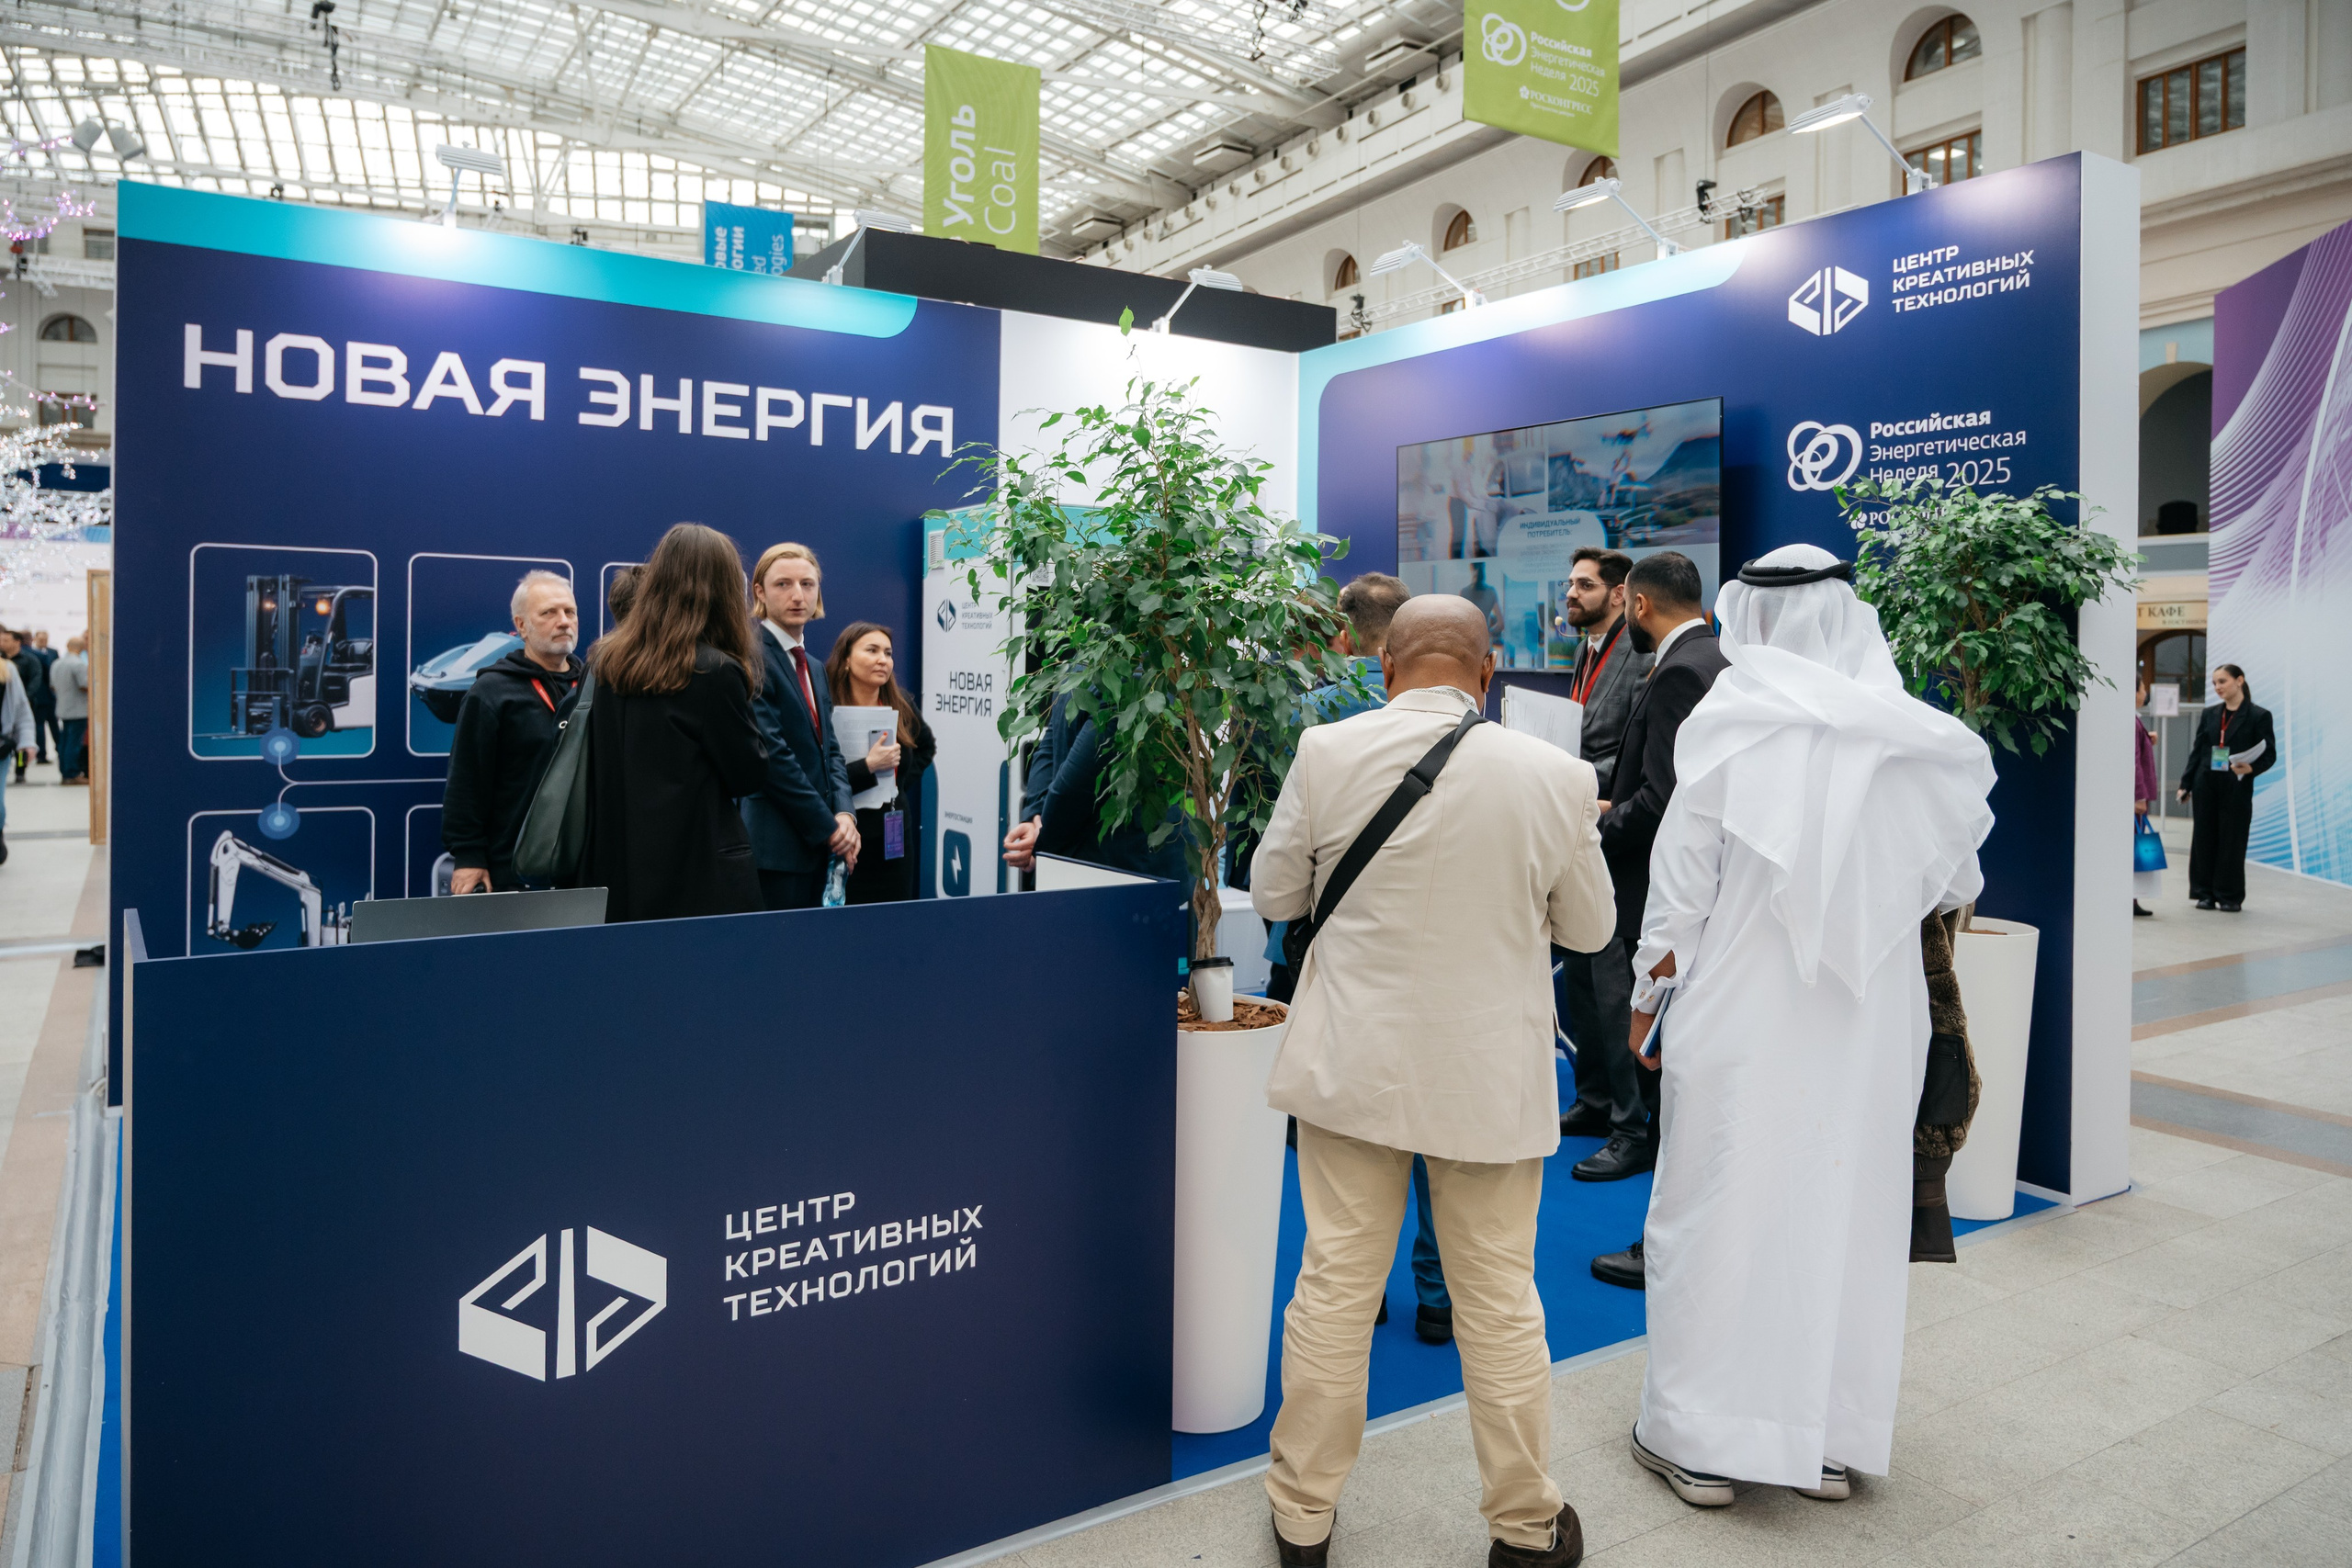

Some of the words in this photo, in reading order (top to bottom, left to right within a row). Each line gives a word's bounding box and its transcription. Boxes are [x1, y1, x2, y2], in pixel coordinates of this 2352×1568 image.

[1531, 31, 1592, 58] Российская
[1531, 47, 1605, 77] Энергетическая
[1531, 62, 1566, 81] Неделя
[1569, 73, 1600, 97] 2025
[1530, 89, 1593, 115] РОСКОНГРЕСС
[944, 104, 976, 228] Уголь
[984, 146, 1016, 235] Coal
[1892, 244, 1960, 274] ЦЕНТР
[1892, 249, 2034, 293] КРЕАТИВНЫХ
[1892, 268, 2030, 313] ТЕХНОЛОГИЙ
[184, 322, 545, 421] НОВАЯ
[578, 367, 954, 458] ЭНЕРГИЯ
[1870, 410, 1992, 439] Российская
[1870, 430, 2027, 463] Энергетическая
[1944, 457, 2011, 489] 2025
[1520, 517, 1580, 530] ИНДИВИДУАЛЬНЫЙ
[961, 620, 992, 629] ТЕХНОЛОГИЙ
[2148, 606, 2185, 617] КАФЕ
[949, 671, 992, 693] НОВАЯ
[935, 694, 992, 716] ЭНЕРГИЯ
[726, 1191, 855, 1241] ЦЕНТР
[726, 1204, 983, 1281] КРЕАТИВНЫХ
[723, 1236, 977, 1321] ТЕХНОЛОГИЙ
